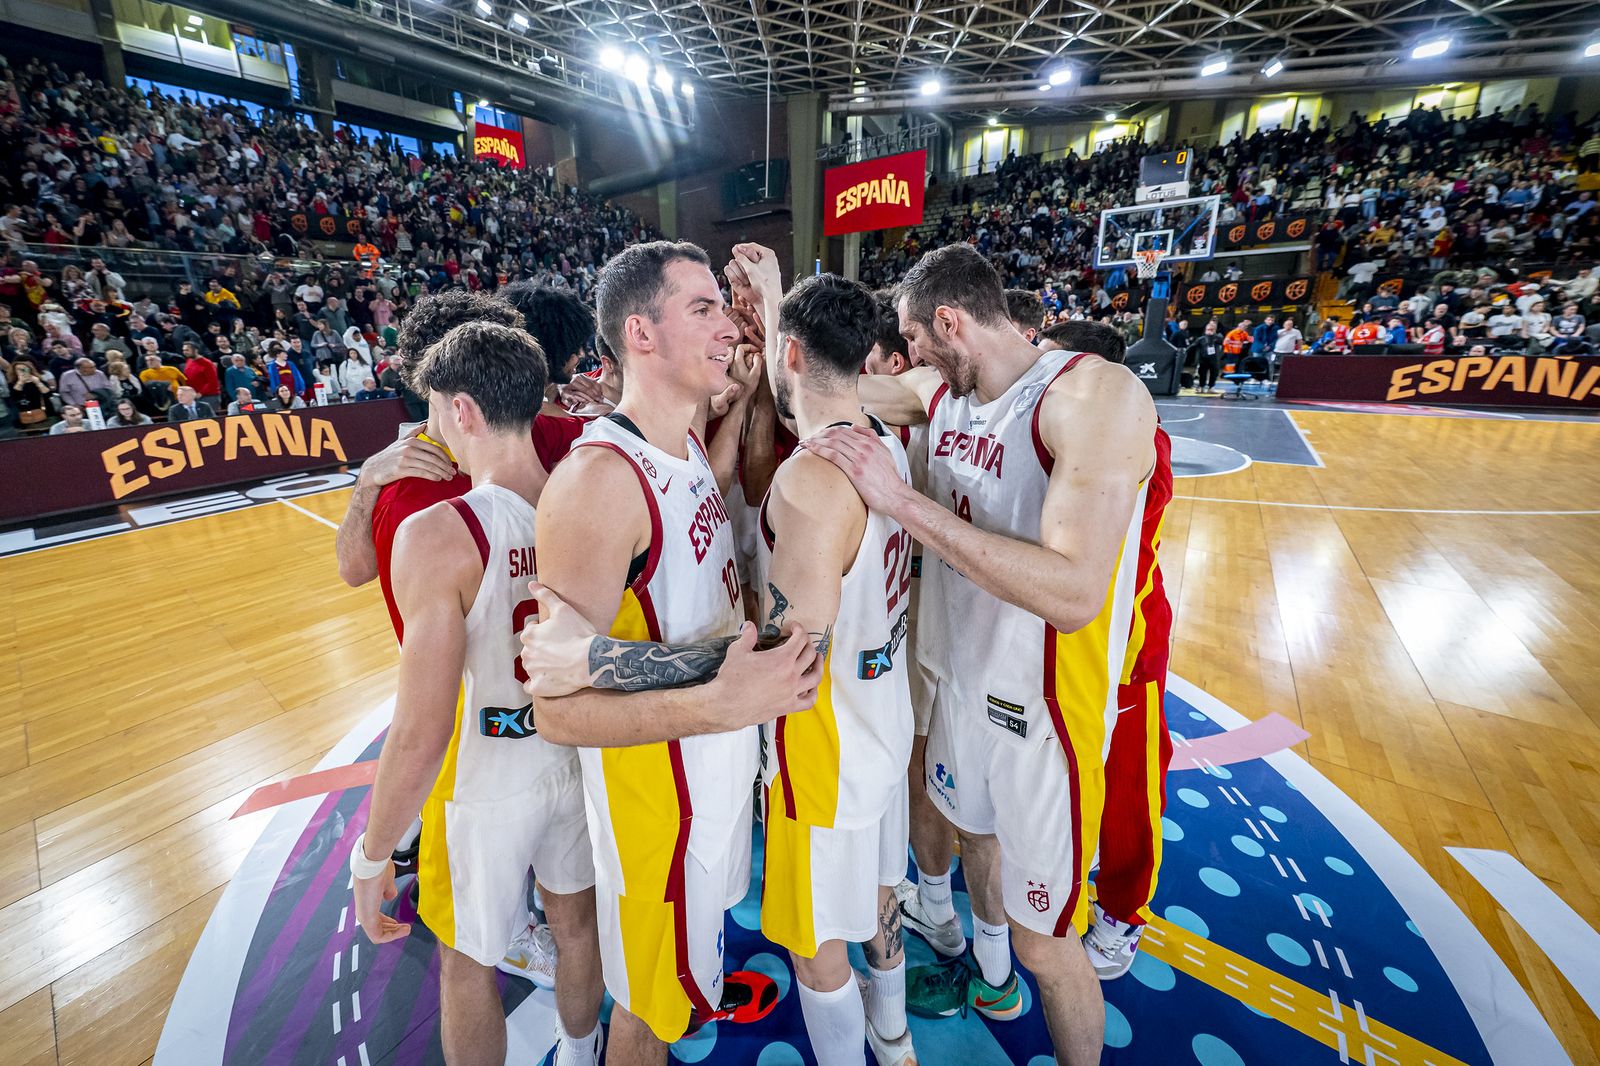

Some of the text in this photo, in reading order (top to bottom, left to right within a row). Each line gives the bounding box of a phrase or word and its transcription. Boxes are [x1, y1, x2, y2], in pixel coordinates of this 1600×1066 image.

[474, 136, 519, 163] ESPAÑA
[836, 173, 911, 218] ESPAÑA
[1146, 188, 1176, 199] LOTUS
[101, 410, 347, 500] ESPAÑA
[722, 558, 739, 610] 10
[1009, 720, 1019, 730] 54
